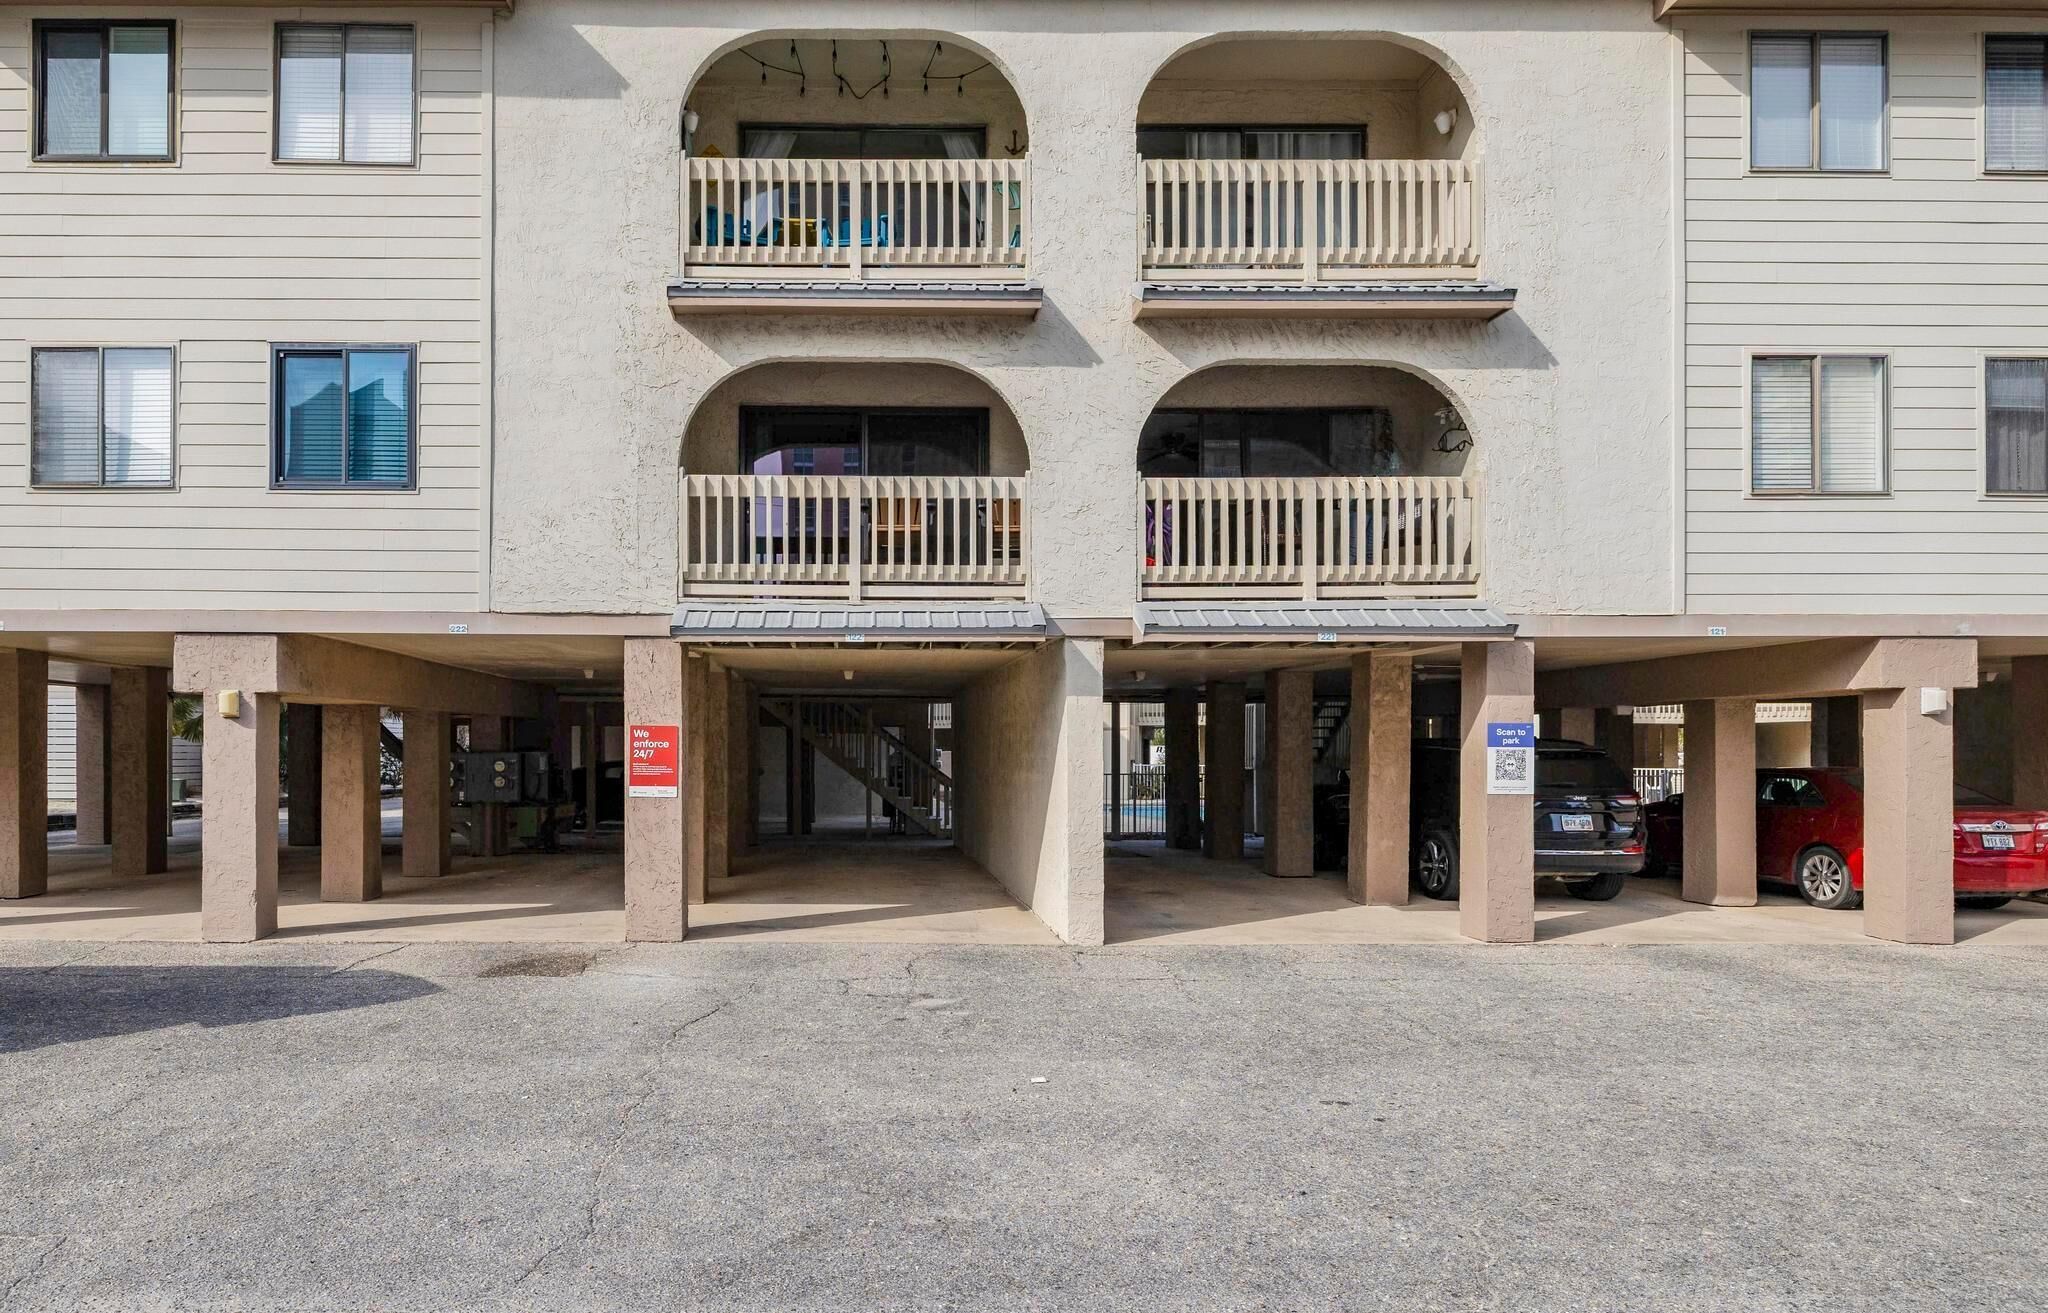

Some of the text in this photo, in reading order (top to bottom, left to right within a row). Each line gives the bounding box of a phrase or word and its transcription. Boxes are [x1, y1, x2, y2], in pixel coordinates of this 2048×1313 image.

[633, 729, 649, 738] We
[1496, 728, 1516, 736] Scan
[633, 739, 669, 748] enforce
[1502, 737, 1520, 746] park
[633, 750, 654, 759] 24/7
